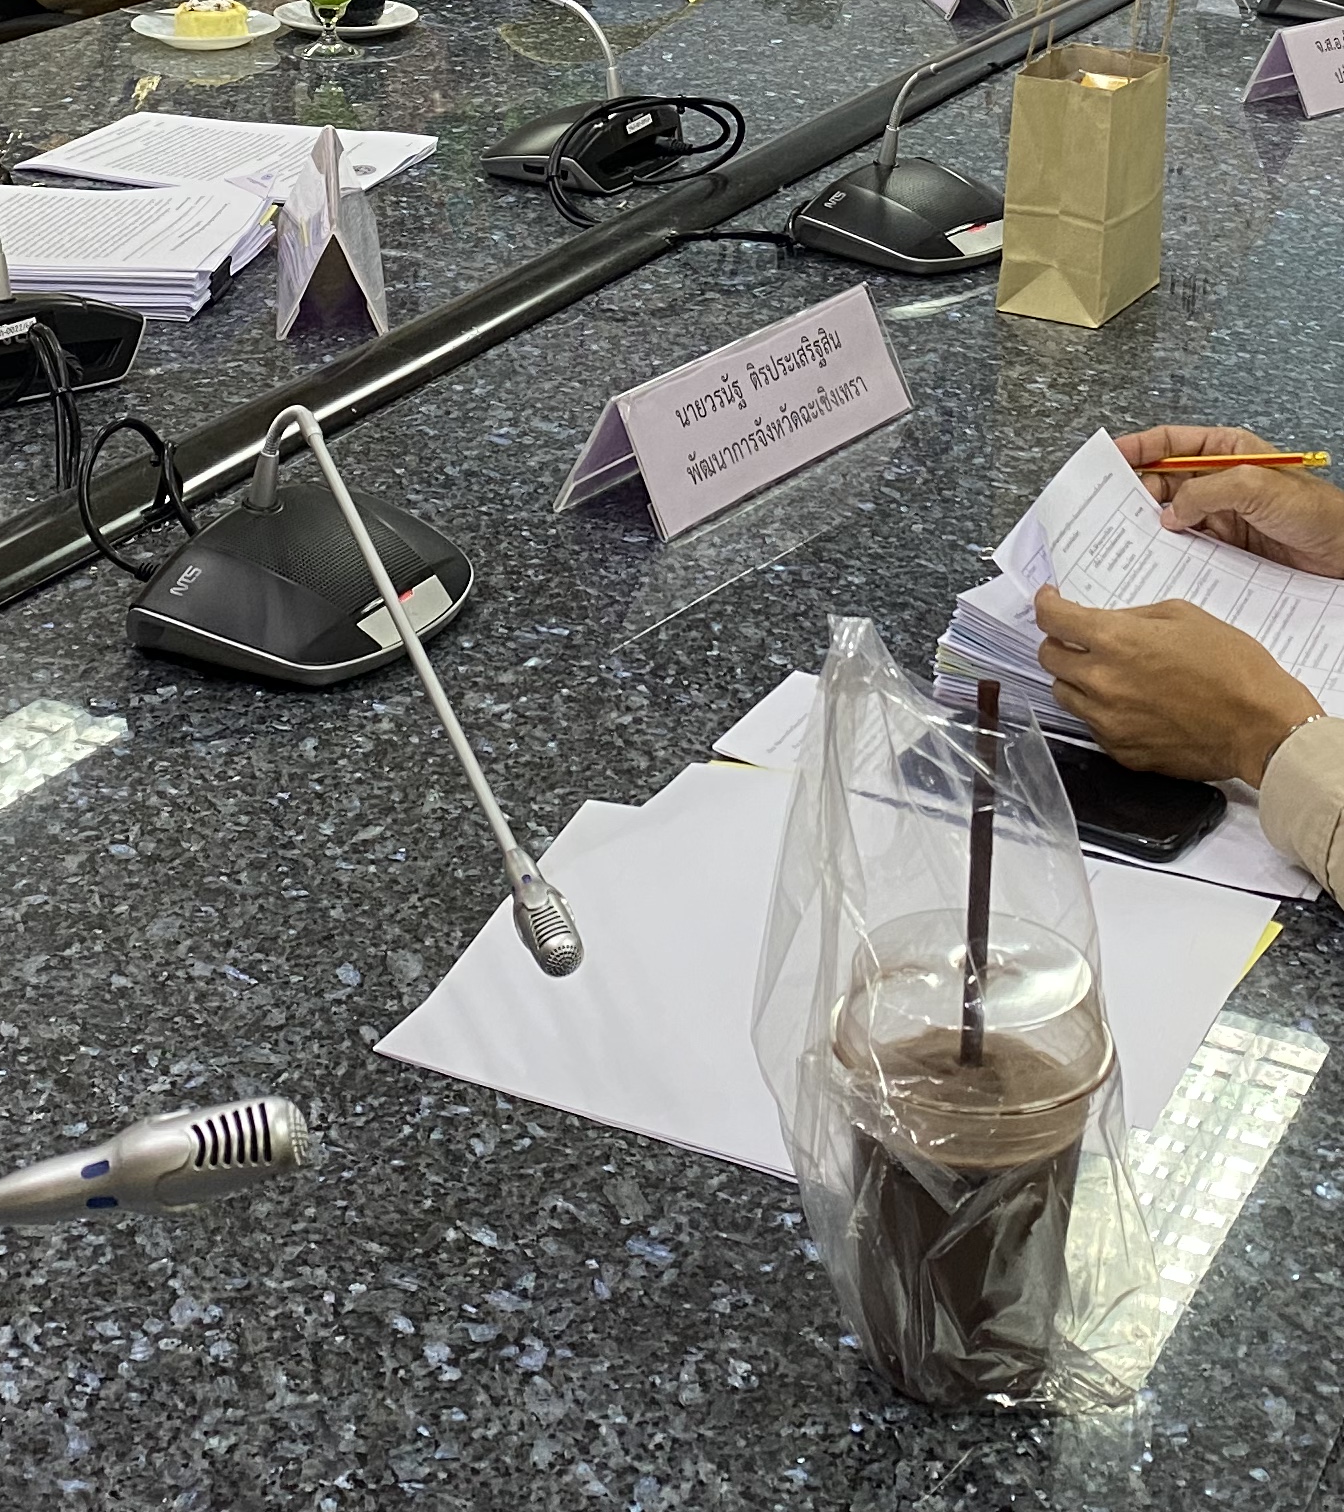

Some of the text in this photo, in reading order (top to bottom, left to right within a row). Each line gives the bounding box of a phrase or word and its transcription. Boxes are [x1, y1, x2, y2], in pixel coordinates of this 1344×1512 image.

[686, 373, 868, 486] พัฒนาการจังหวัดฉะเชิงเทรา
